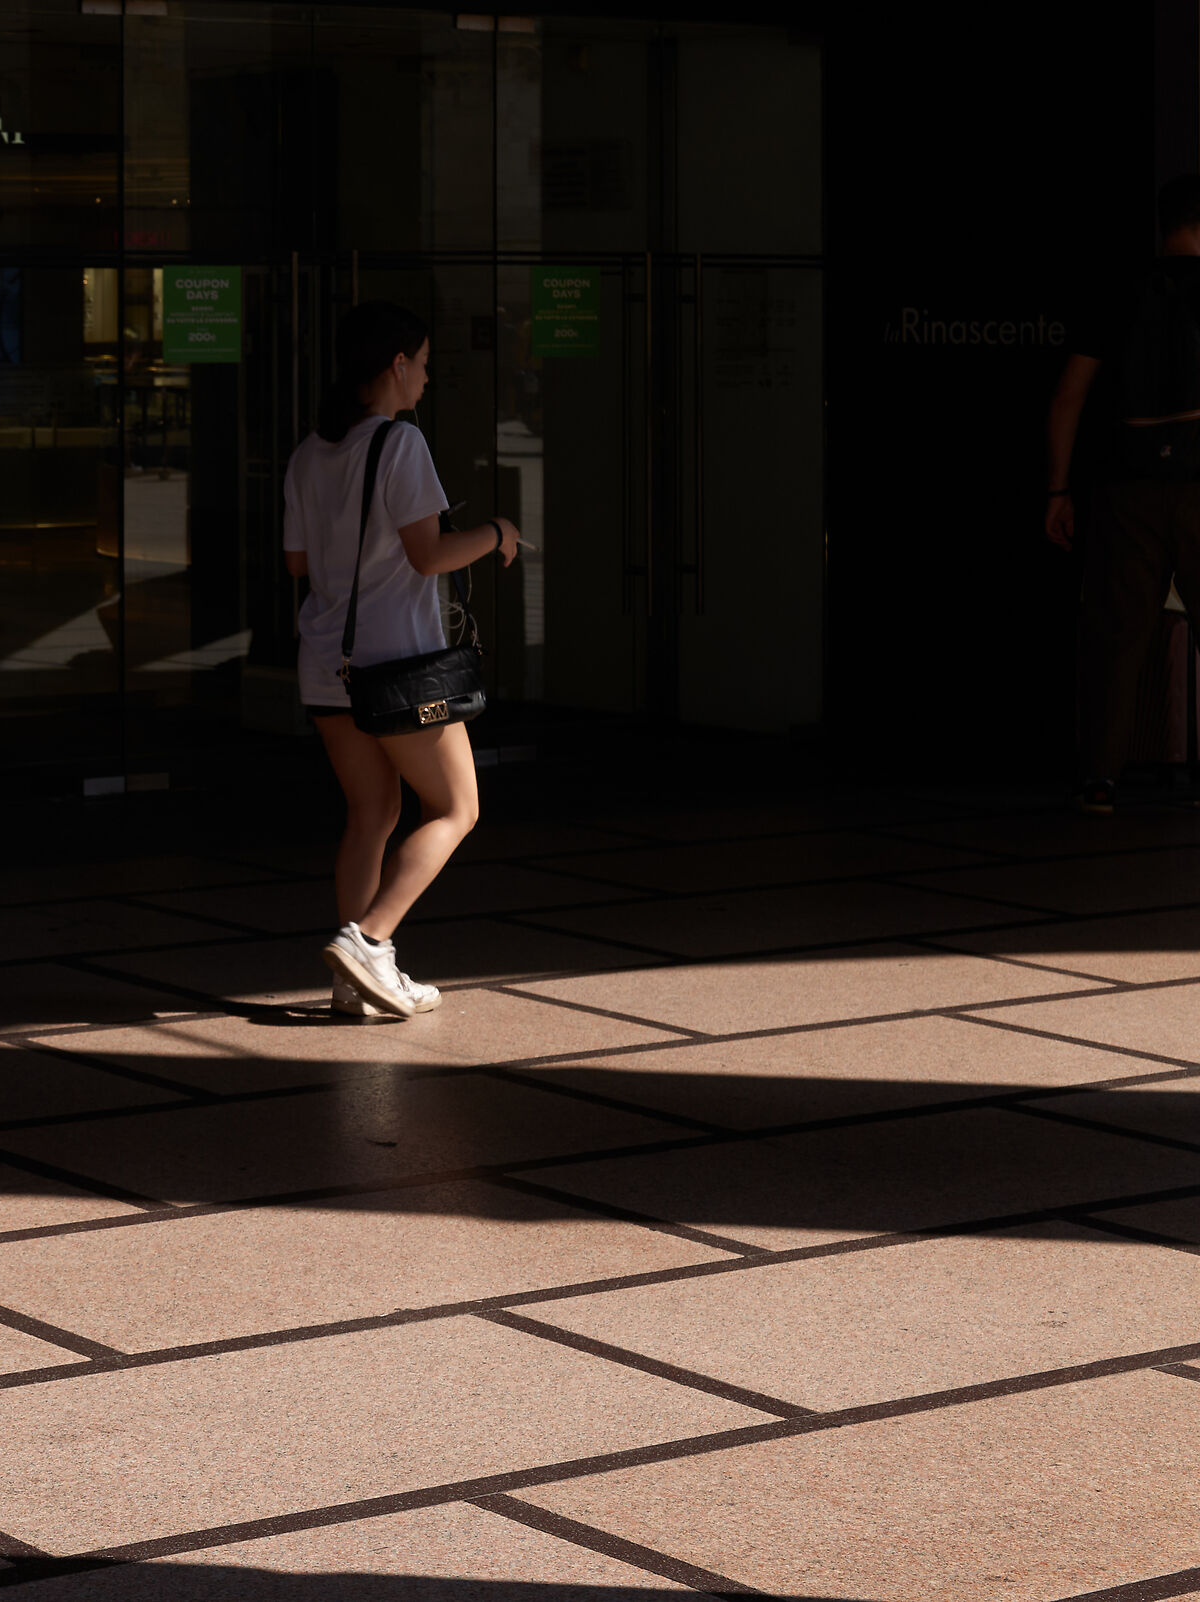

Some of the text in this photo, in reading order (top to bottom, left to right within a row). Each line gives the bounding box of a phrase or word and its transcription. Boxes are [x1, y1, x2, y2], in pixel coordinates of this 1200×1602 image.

[175, 278, 230, 289] COUPON
[543, 277, 592, 289] COUPON
[186, 289, 219, 300] DAYS
[552, 288, 582, 299] DAYS
[900, 305, 1066, 346] Rinascente
